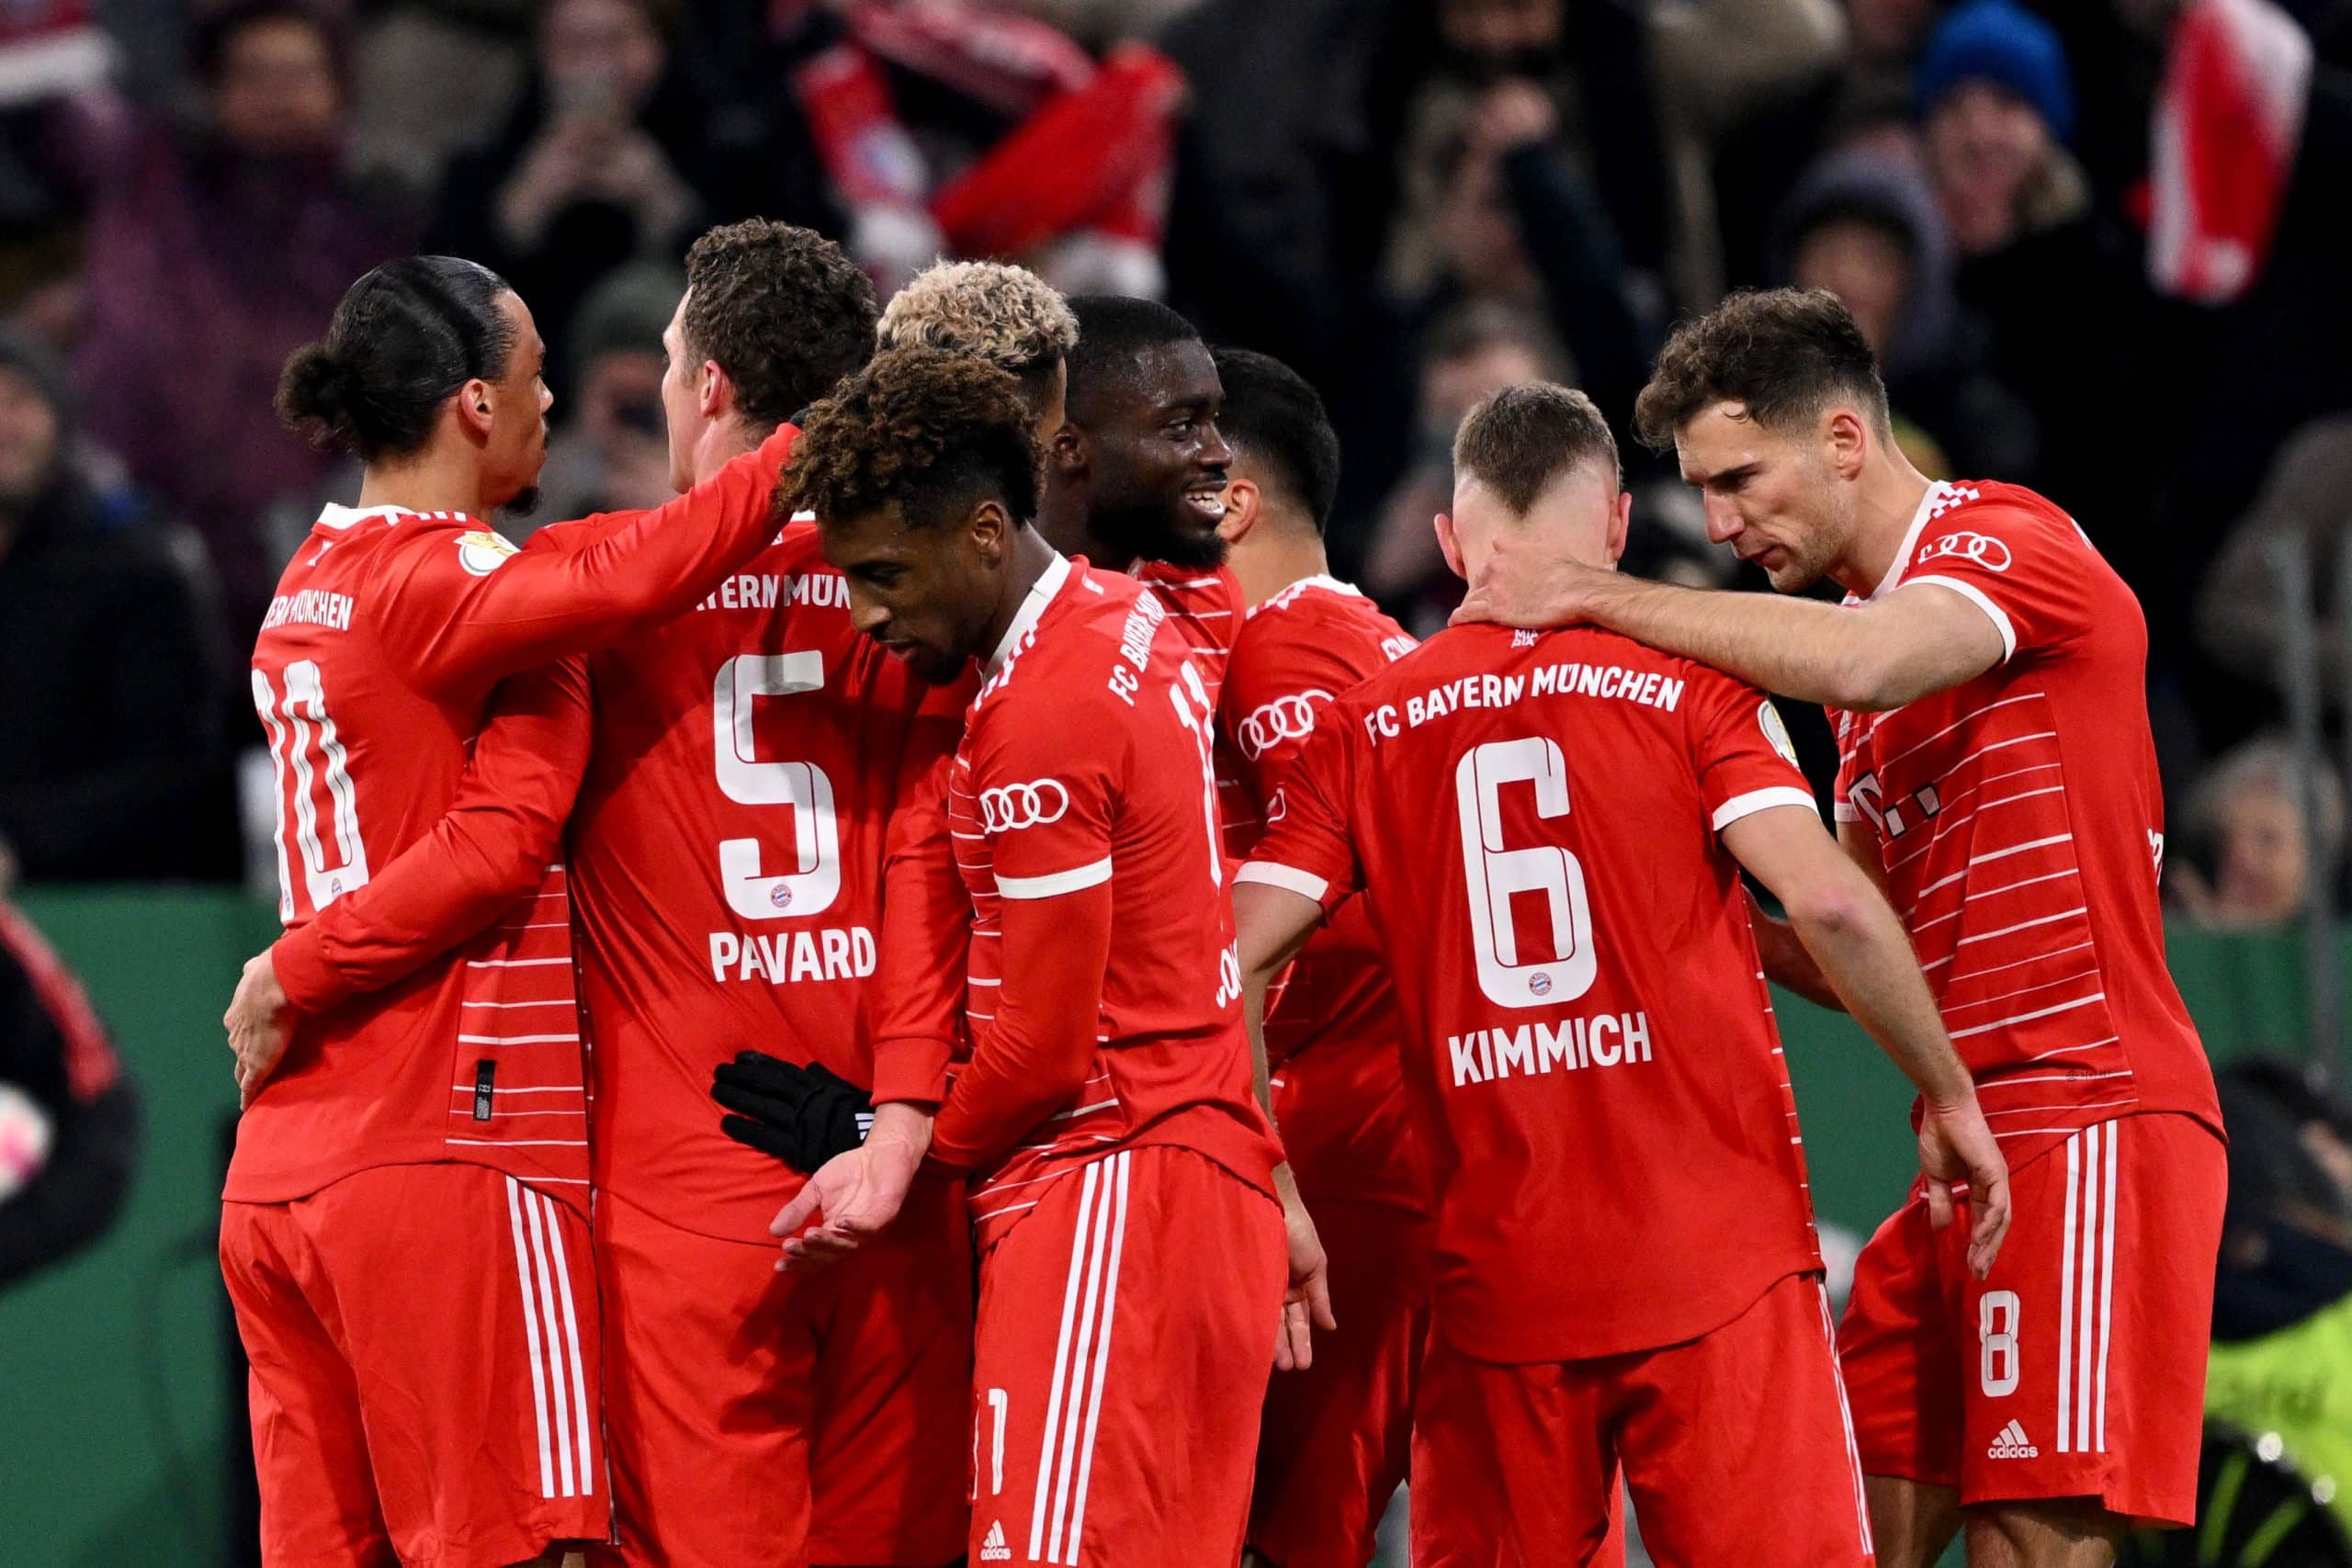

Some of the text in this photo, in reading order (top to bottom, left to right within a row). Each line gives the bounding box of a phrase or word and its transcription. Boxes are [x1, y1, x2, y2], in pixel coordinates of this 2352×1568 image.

[1108, 664, 1139, 706] FC
[1363, 663, 1685, 748] FC BAYERN MÜNCHEN
[251, 659, 369, 921] 10
[714, 650, 841, 919] 5
[1455, 736, 1598, 1009] 6
[708, 926, 876, 985] PAVARD
[1448, 1011, 1653, 1088] KIMMICH
[1979, 1290, 2020, 1398] 8
[1987, 1444, 2040, 1460] adidas
